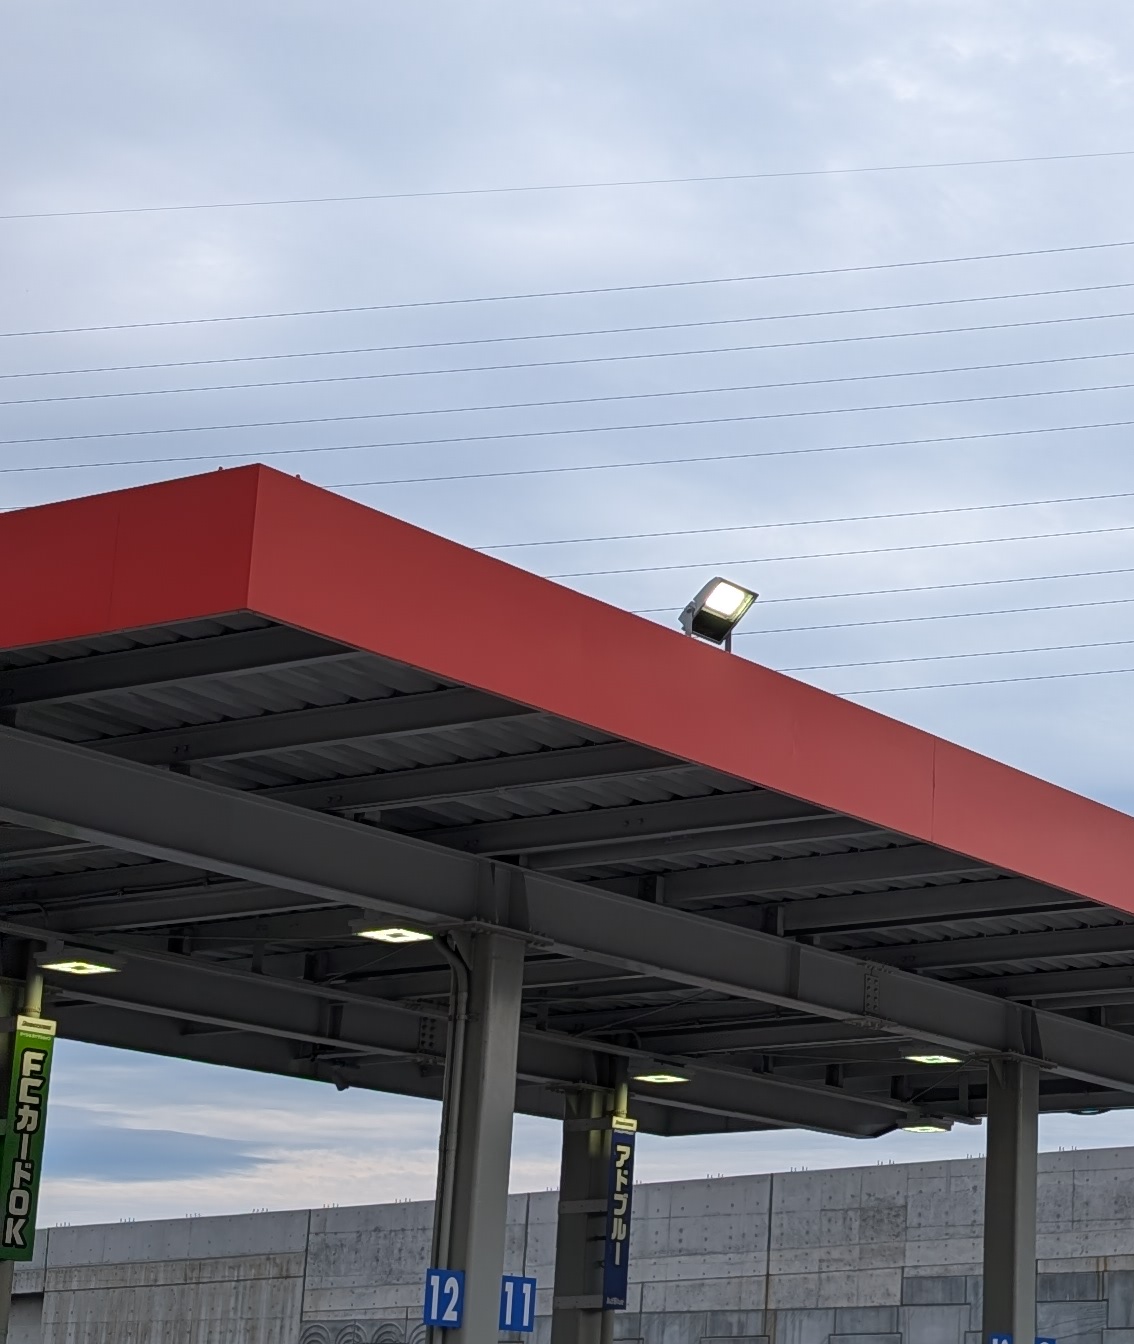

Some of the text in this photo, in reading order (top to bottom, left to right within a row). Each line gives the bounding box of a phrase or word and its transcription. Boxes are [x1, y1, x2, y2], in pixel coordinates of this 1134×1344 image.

[5, 1051, 46, 1246] FCカードOK
[611, 1145, 631, 1266] アドブルー
[430, 1273, 459, 1322] 12
[503, 1280, 531, 1327] 11
